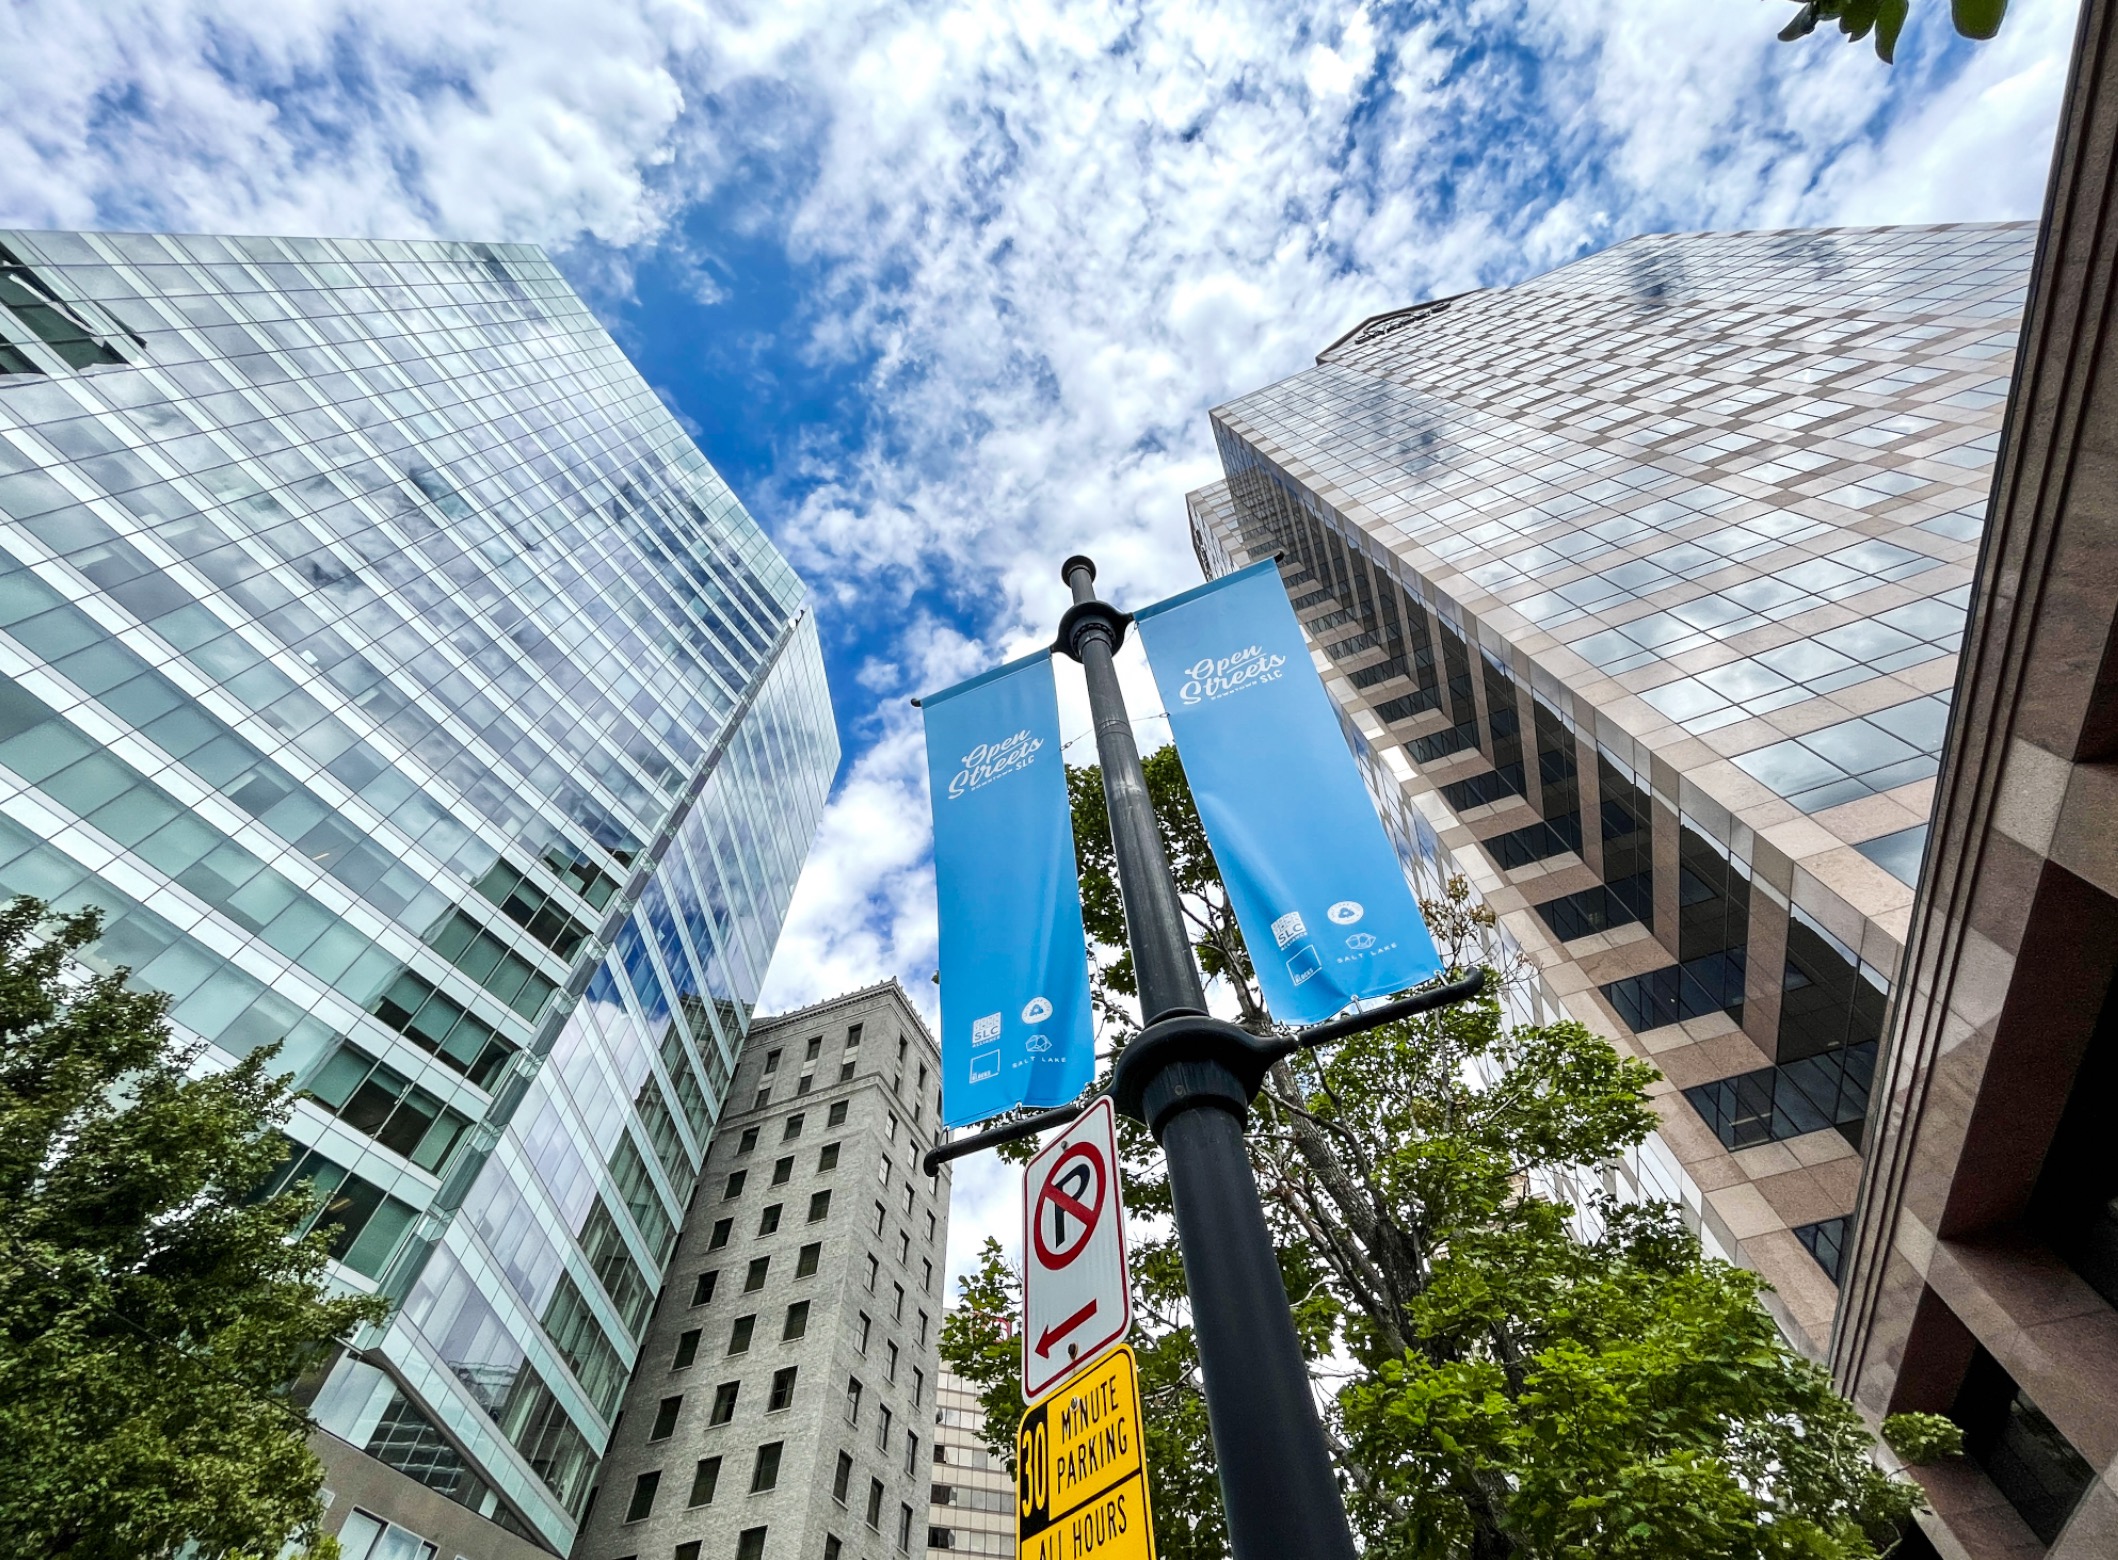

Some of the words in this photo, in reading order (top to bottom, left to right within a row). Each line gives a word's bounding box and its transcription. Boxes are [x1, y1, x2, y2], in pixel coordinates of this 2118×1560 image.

[1179, 654, 1286, 705] Streets
[1184, 645, 1262, 680] Open
[1259, 669, 1283, 684] SLC
[961, 729, 1031, 769] Open
[1015, 755, 1035, 771] SLC
[947, 738, 1044, 800] Streets
[1278, 923, 1303, 944] SLC
[1336, 952, 1363, 964] SALT
[1370, 942, 1398, 956] LAKE
[974, 1026, 999, 1041] SLC
[1012, 1056, 1035, 1069] SALT
[1061, 1375, 1119, 1445] MINUTE
[1021, 1421, 1047, 1518] 30
[1057, 1416, 1127, 1495] PARKING
[1073, 1494, 1127, 1559] HOURS
